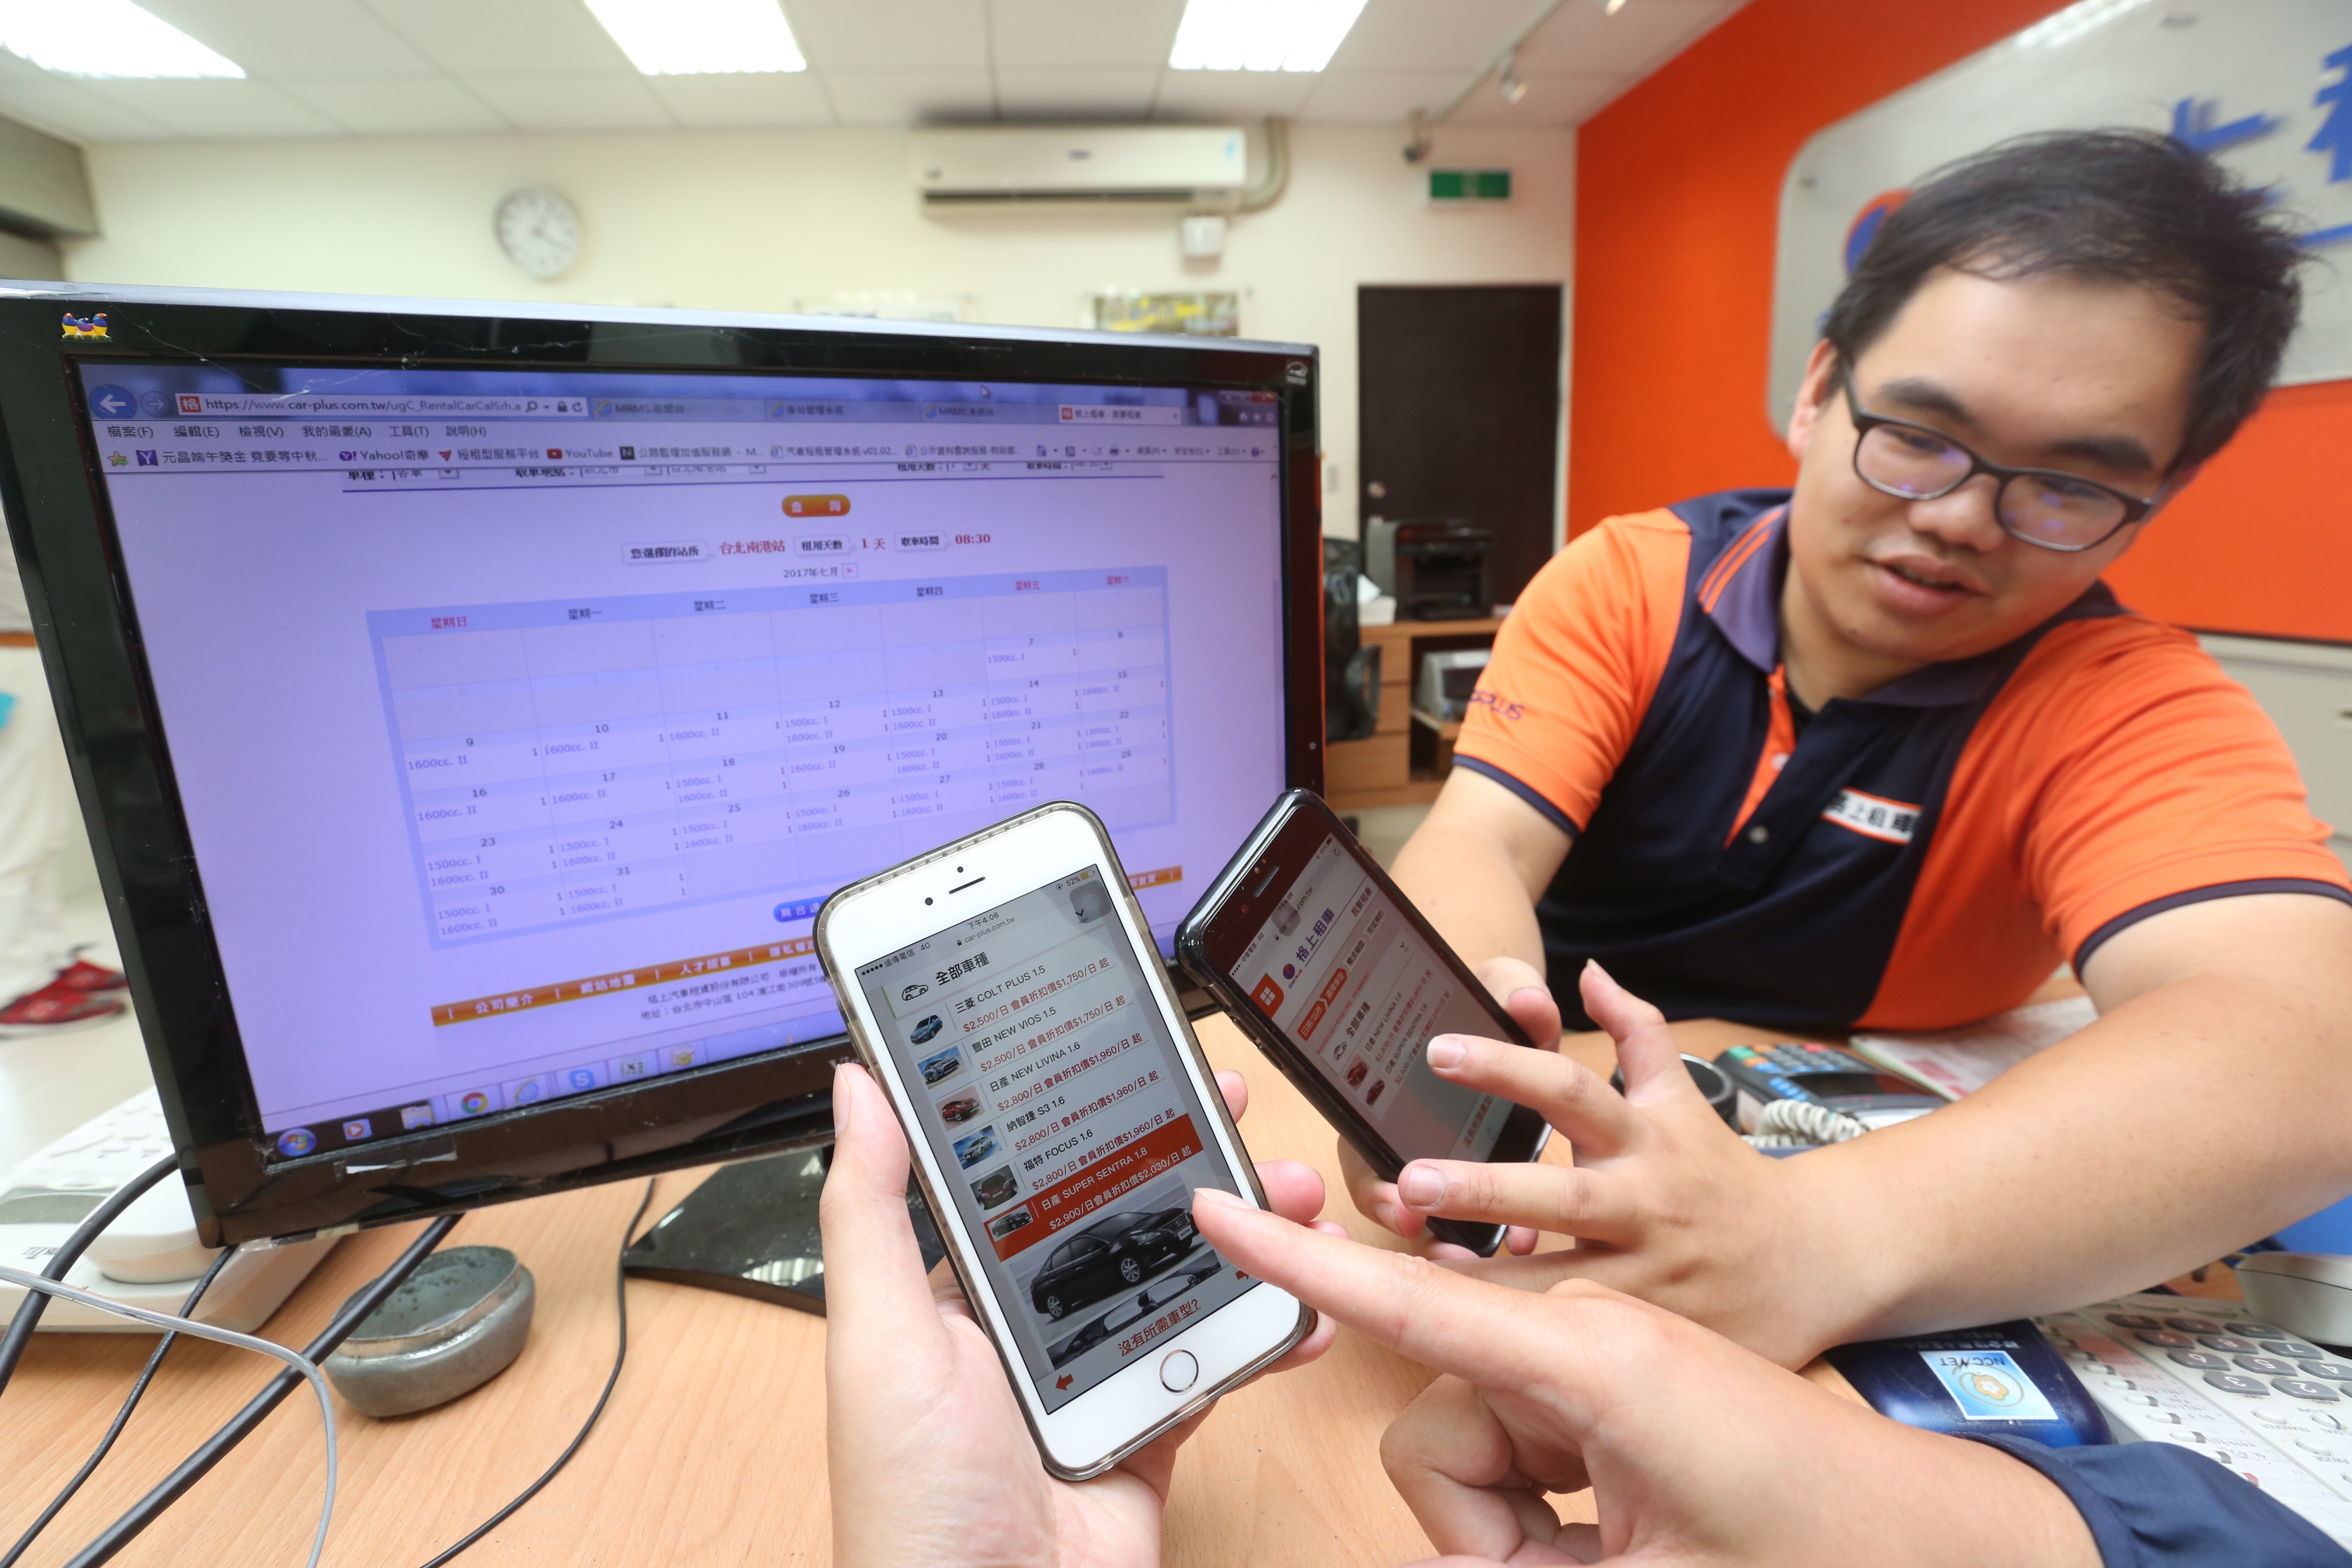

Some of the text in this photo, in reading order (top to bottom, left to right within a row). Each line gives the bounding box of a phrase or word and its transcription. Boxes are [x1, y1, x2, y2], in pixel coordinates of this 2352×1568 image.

[108, 425, 153, 439] 檔案(F)
[174, 426, 219, 439] 編輯(E)
[239, 426, 283, 438] 檢視(V)
[303, 425, 372, 438] 我的最愛(A)
[390, 425, 429, 437] 工具(T)
[445, 425, 486, 437] 說明(H)
[163, 450, 246, 463] 元晶端午獎金
[361, 449, 429, 461] Yahoo!奇摩
[565, 449, 613, 458] YouTube
[630, 545, 699, 560] 您選擇的站所
[719, 540, 786, 555] 台北南港站
[802, 539, 843, 551] 租用天數
[861, 538, 885, 550] 1 天
[901, 535, 940, 546] 取車時間
[955, 534, 991, 545] 08:30
[783, 566, 838, 578] 2017年七月
[431, 616, 468, 630] 星期日
[568, 608, 602, 620] 星期一
[694, 599, 726, 612] 星期二
[809, 592, 839, 604] 星期三
[916, 586, 944, 597] 星期四
[1016, 580, 1040, 591] 星期五
[1029, 637, 1034, 646] 7
[466, 737, 474, 747] 9
[595, 724, 609, 733] 10
[717, 711, 729, 720] 11
[829, 700, 840, 708] 12
[408, 756, 454, 771] 1600cc.
[472, 788, 487, 798] 16
[602, 773, 615, 782] 17
[722, 758, 735, 767] 18
[833, 745, 845, 753] 19
[1119, 710, 1130, 719] 22
[418, 807, 464, 821] 1600cc.
[480, 838, 496, 848] 23
[609, 820, 623, 829] 24
[728, 804, 741, 813] 25
[837, 789, 850, 797] 26
[939, 775, 951, 783] 27
[1034, 762, 1044, 770] 28
[430, 873, 475, 887] 1600cc.
[490, 867, 630, 895] 30 31
[920, 942, 931, 951] 4G
[967, 912, 1000, 930] 下午4:06
[1066, 876, 1081, 886] 52%
[1279, 886, 1314, 934] car-plus.com.tw
[1350, 886, 1373, 917] 我要租車
[964, 916, 1015, 943] car-plus.com.tw
[1258, 933, 1264, 941] 4G
[1295, 907, 1336, 962] 格上租車
[935, 951, 990, 986] 全部車種
[1288, 968, 1303, 989] CARPLUS
[475, 992, 534, 1013] 公司簡介
[580, 973, 636, 994] 網站地圖
[955, 965, 1045, 1013] 三菱 COLT PLUS 1.5
[962, 957, 1110, 1033] $2,500/日 會員折扣價$1,750/日 起
[971, 1007, 1057, 1054] 豐田 NEW VIOS 1.5
[1300, 1005, 1323, 1036] 日期/站所
[1346, 1001, 1371, 1038] 全部車種
[1365, 1038, 1375, 1052] 日產
[1374, 1020, 1384, 1038] NEW
[1383, 1001, 1396, 1021] LIVINA
[980, 995, 1126, 1073] $2,500/日 會員折扣價$1,750/日 起
[1385, 1060, 1395, 1074] 日產
[1394, 1036, 1407, 1060] SUPER
[1406, 1013, 1421, 1037] SENTRA
[990, 1041, 1081, 1093] 日產 NEW LIVINA 1.6
[997, 1033, 1143, 1112] $2,800/日 會員折扣價$1,960/日 起
[1006, 1096, 1065, 1132] 納智捷 S3 1.6
[1015, 1070, 1159, 1152] $2,800/日 會員折扣價$1,960/日 起
[1023, 1129, 1094, 1172] 福特 FOCUS 1.6
[1031, 1107, 1176, 1191] $2,800/日 會員折扣價$1,960/日 起
[1181, 1145, 1193, 1157] 起
[1041, 1147, 1148, 1212] 日產 SUPER SENTRA 1.8
[1118, 1298, 1201, 1356] 沒有所需車型?
[2253, 1358, 2276, 1369] 5
[2224, 1376, 2246, 1388] 3
[2289, 1381, 2317, 1394] 2
[2260, 1423, 2311, 1432] TRANSFER
